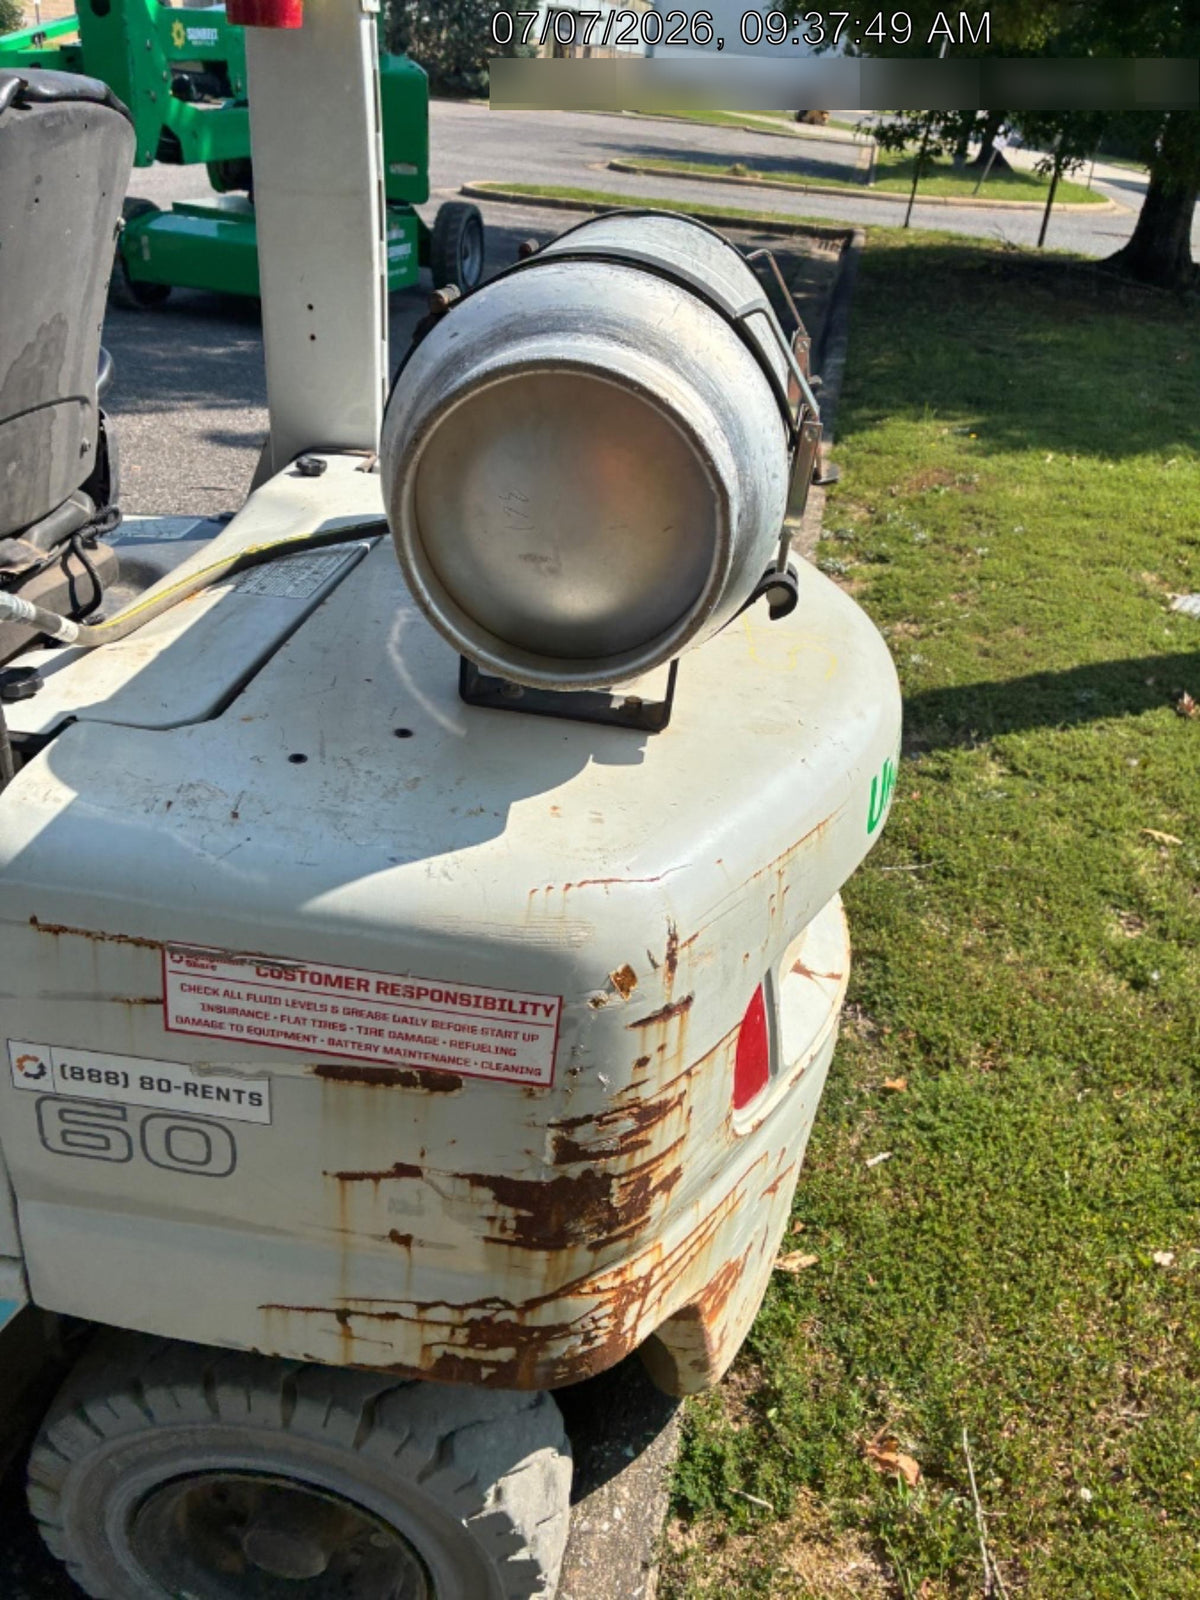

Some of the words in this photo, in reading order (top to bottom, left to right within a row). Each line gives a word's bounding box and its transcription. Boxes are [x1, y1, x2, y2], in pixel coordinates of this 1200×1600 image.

[180, 982, 220, 998] CHECK
[223, 989, 243, 1001] ALL
[246, 993, 282, 1006] FLUID
[285, 998, 328, 1013] LEVELS
[342, 1006, 391, 1022] GREASE
[392, 1013, 428, 1027] DAILY
[431, 1019, 478, 1035] BEFORE
[480, 1027, 520, 1040] START
[522, 1032, 540, 1043] UP
[255, 965, 370, 993] CUSTOMER
[375, 980, 555, 1018] RESPONSIBILITY
[175, 1015, 226, 1030] DAMAGE
[229, 1022, 244, 1033] TO
[246, 1025, 319, 1044] EQUIPMENT
[327, 1037, 381, 1054] BATTERY
[383, 1045, 472, 1067] MAINTENANCE
[480, 1060, 543, 1077] CLEANING
[200, 1002, 271, 1020] INSURANCE
[280, 1014, 308, 1028] FLAT
[311, 1018, 347, 1032] TIRES
[356, 1025, 385, 1038] TIRE
[388, 1030, 440, 1046] DAMAGE
[449, 1039, 517, 1057] REFUELING
[60, 1062, 130, 1089] (888)
[139, 1076, 264, 1108] 80-RENTS
[35, 1095, 238, 1178] 60
